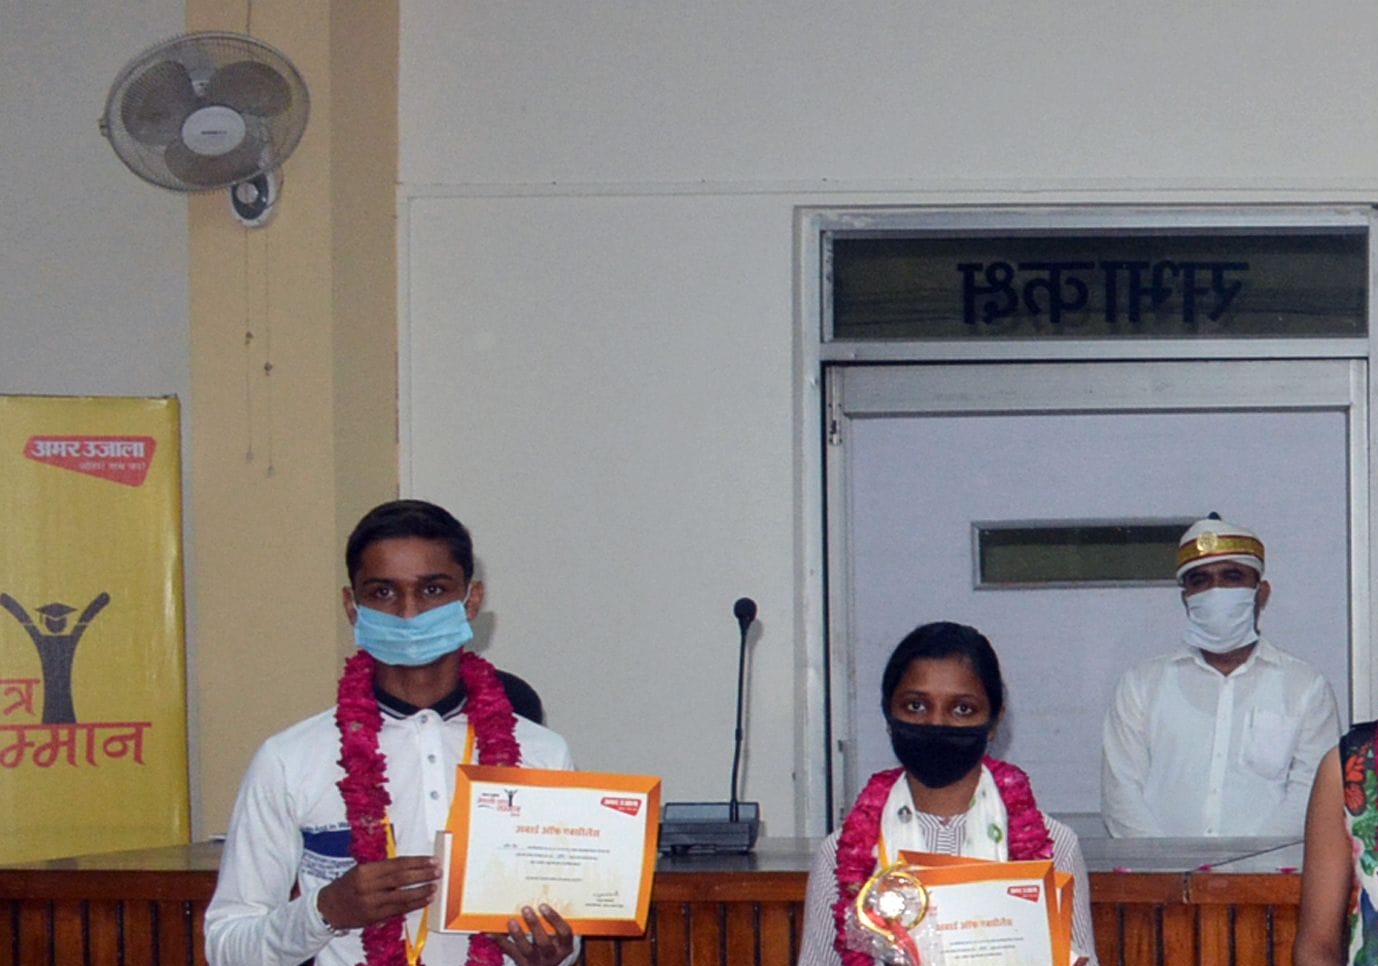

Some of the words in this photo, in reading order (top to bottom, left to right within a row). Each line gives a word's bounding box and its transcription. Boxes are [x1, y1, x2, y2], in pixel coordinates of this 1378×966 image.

[31, 441, 80, 457] अमर
[82, 441, 145, 457] उजाला
[0, 678, 40, 716] त्र
[0, 722, 152, 769] म्मान
